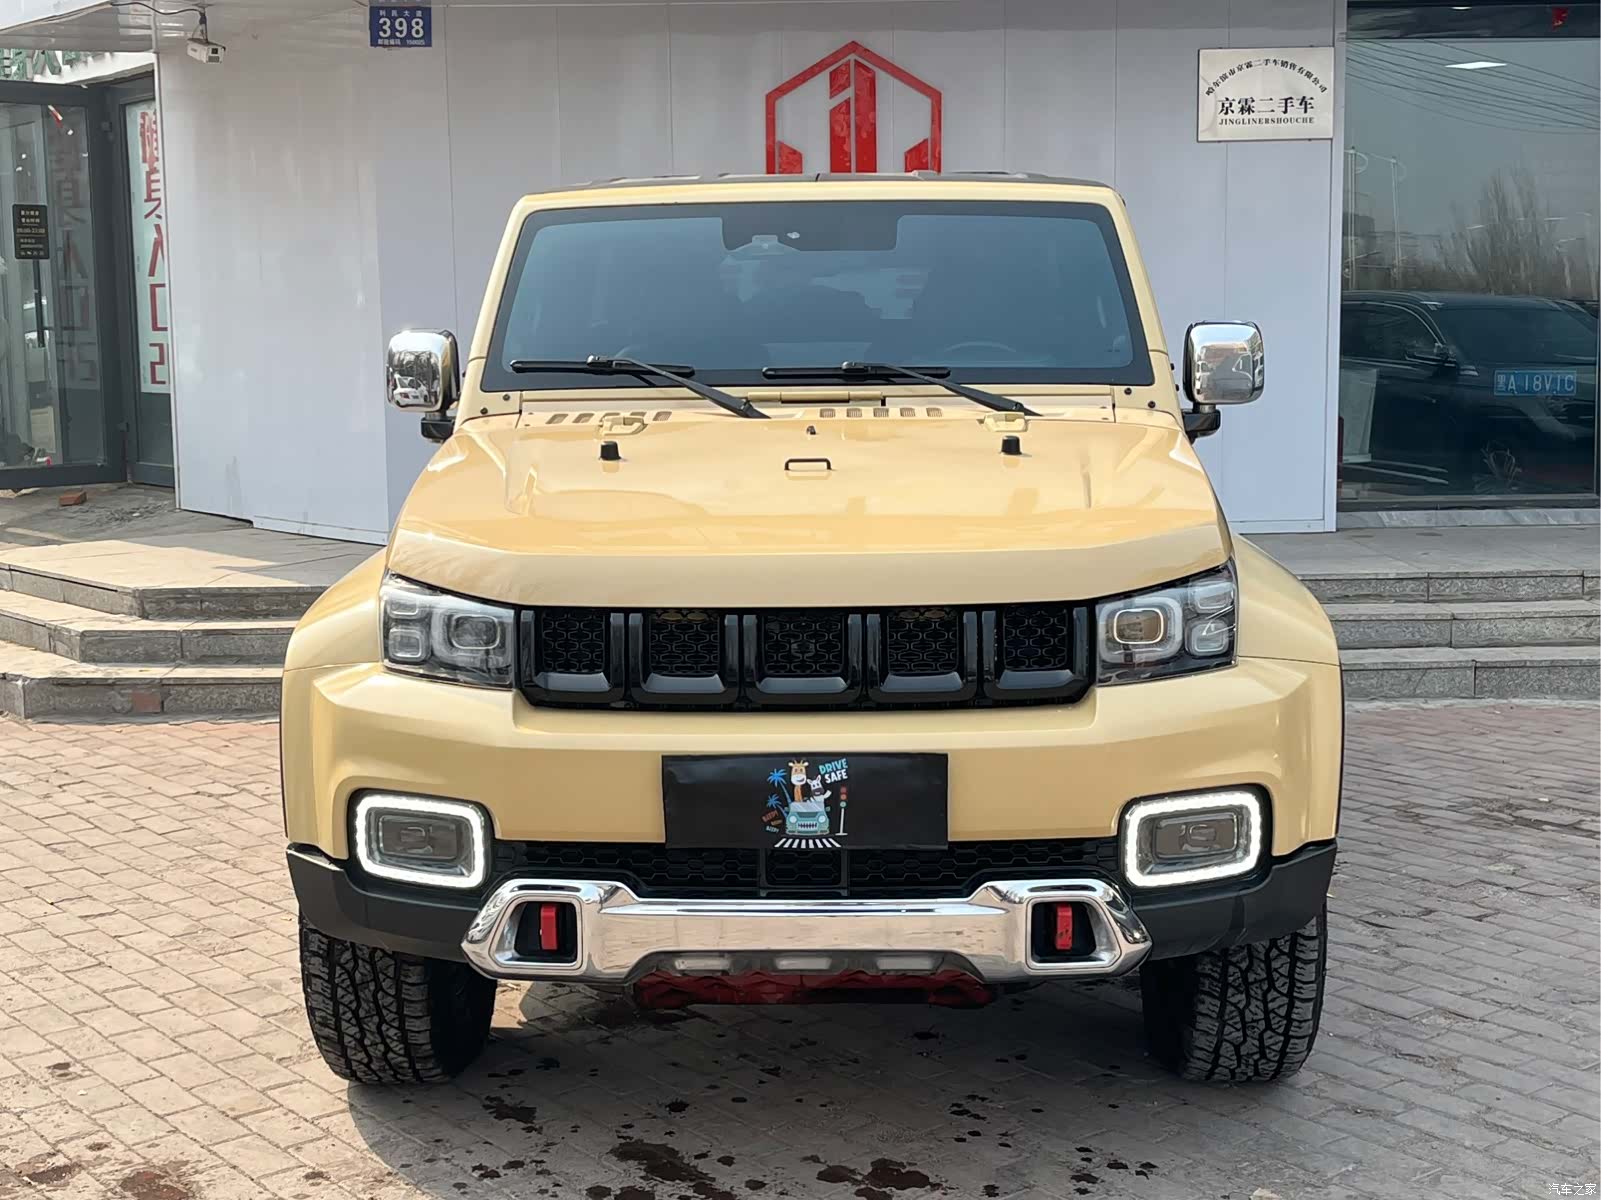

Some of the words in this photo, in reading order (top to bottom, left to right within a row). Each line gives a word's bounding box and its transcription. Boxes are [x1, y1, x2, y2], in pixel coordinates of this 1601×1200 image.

[378, 17, 424, 38] 398
[1217, 95, 1315, 116] 京霖二手车
[1218, 116, 1315, 126] JINGLINERSHOUCHE
[818, 758, 848, 775] DRIVE
[824, 769, 848, 784] SAFE
